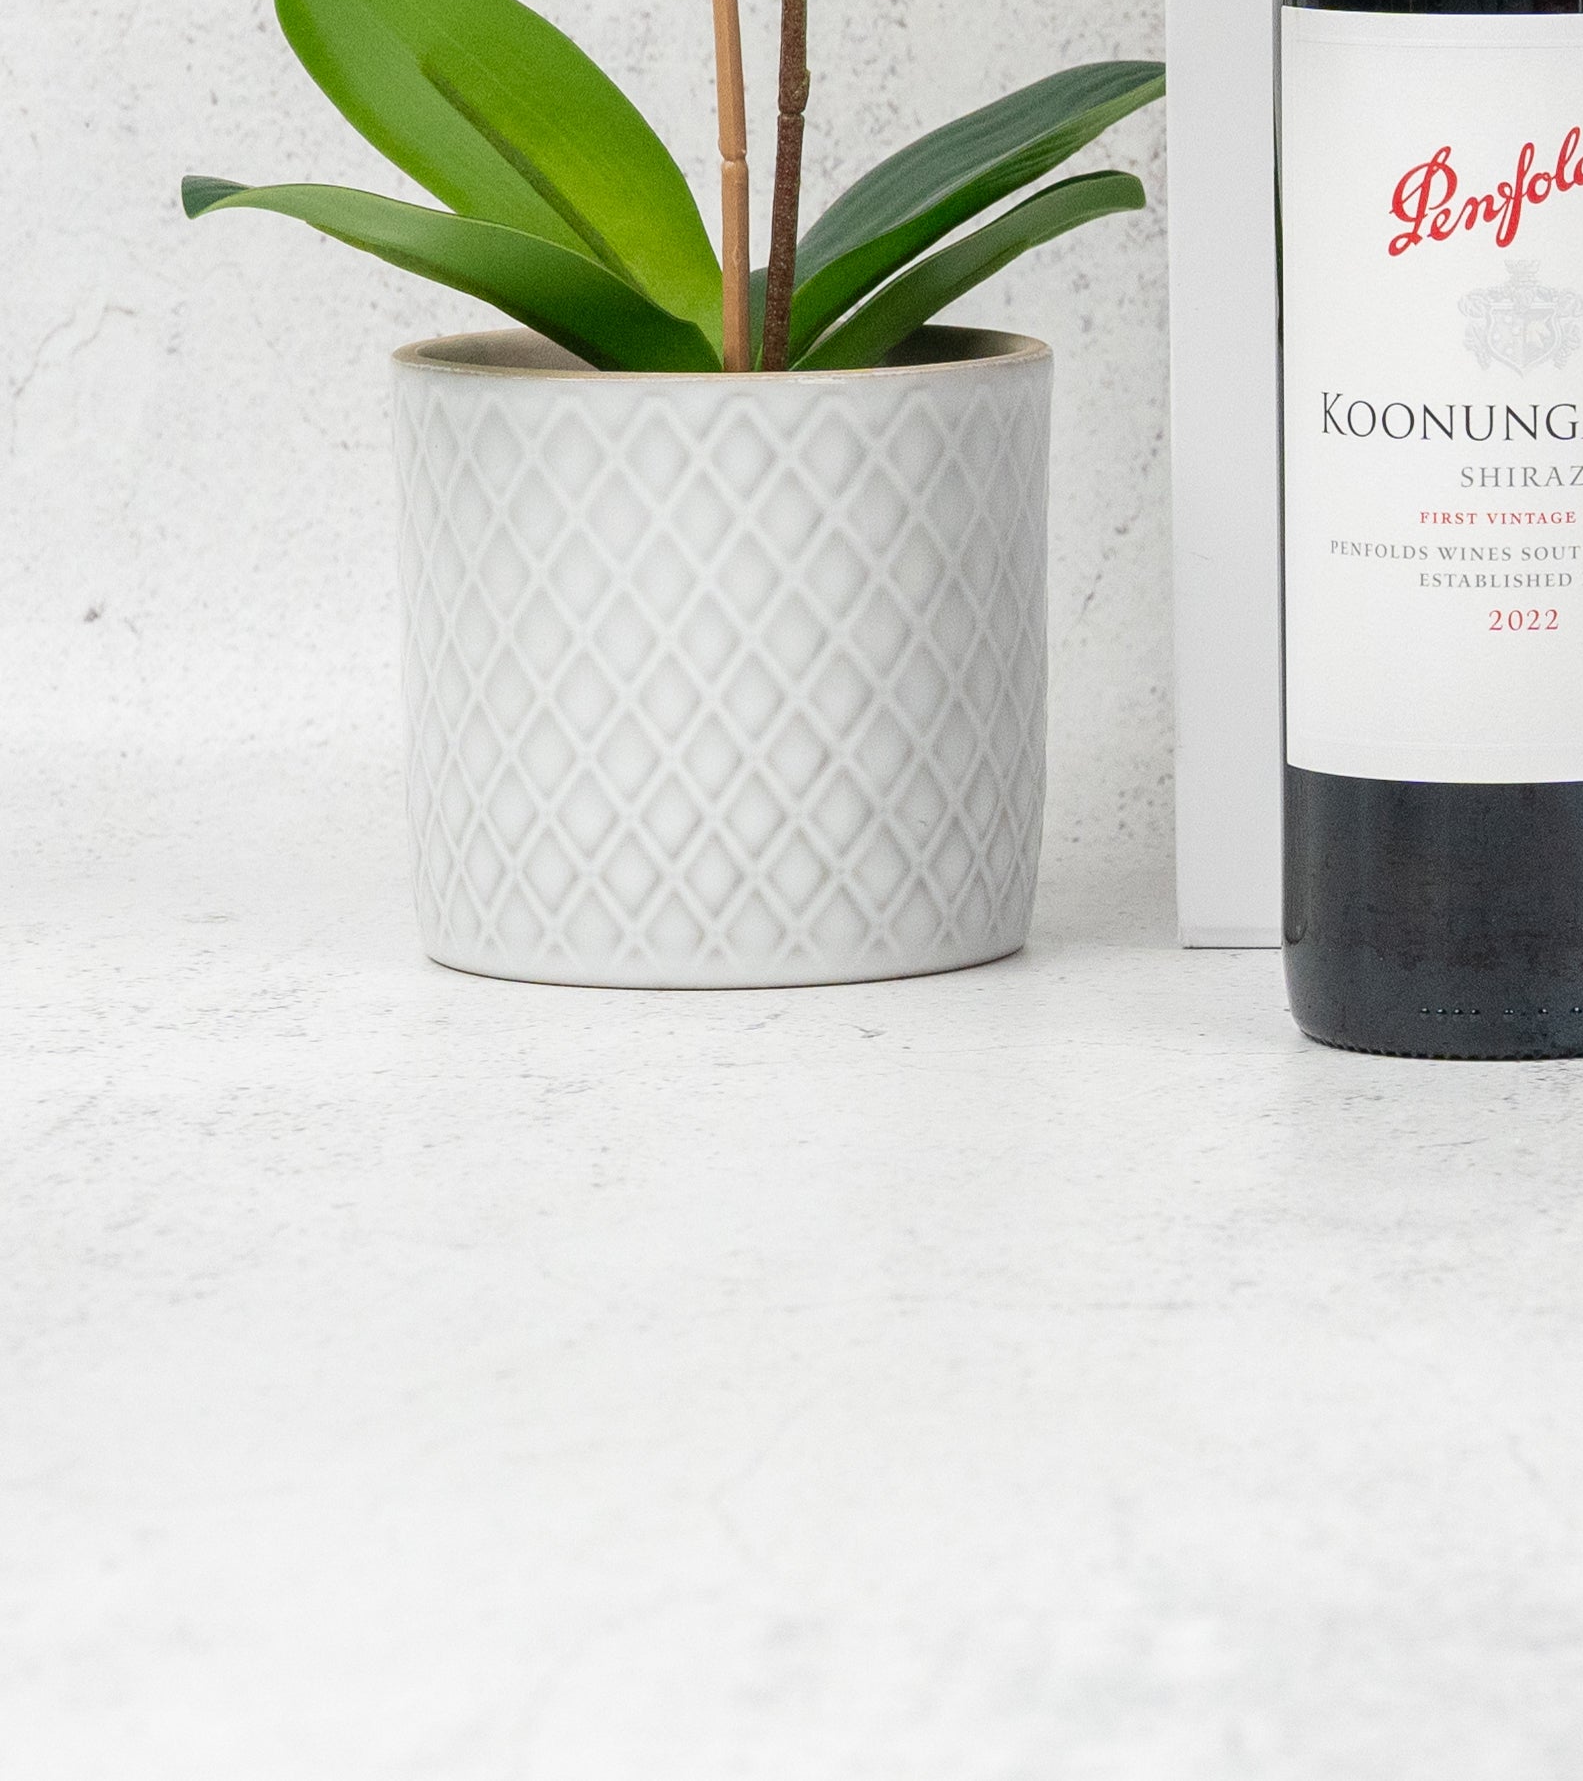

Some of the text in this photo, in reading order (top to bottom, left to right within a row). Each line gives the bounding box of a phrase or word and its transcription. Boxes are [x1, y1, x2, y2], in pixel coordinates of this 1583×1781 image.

[1419, 511, 1478, 525] FIRST
[1486, 511, 1577, 525] VINTAGE
[1330, 539, 1429, 561] PENFOLDS
[1437, 546, 1512, 562] WINES
[1419, 573, 1573, 588] ESTABLISHED
[1488, 608, 1560, 632] 2022
